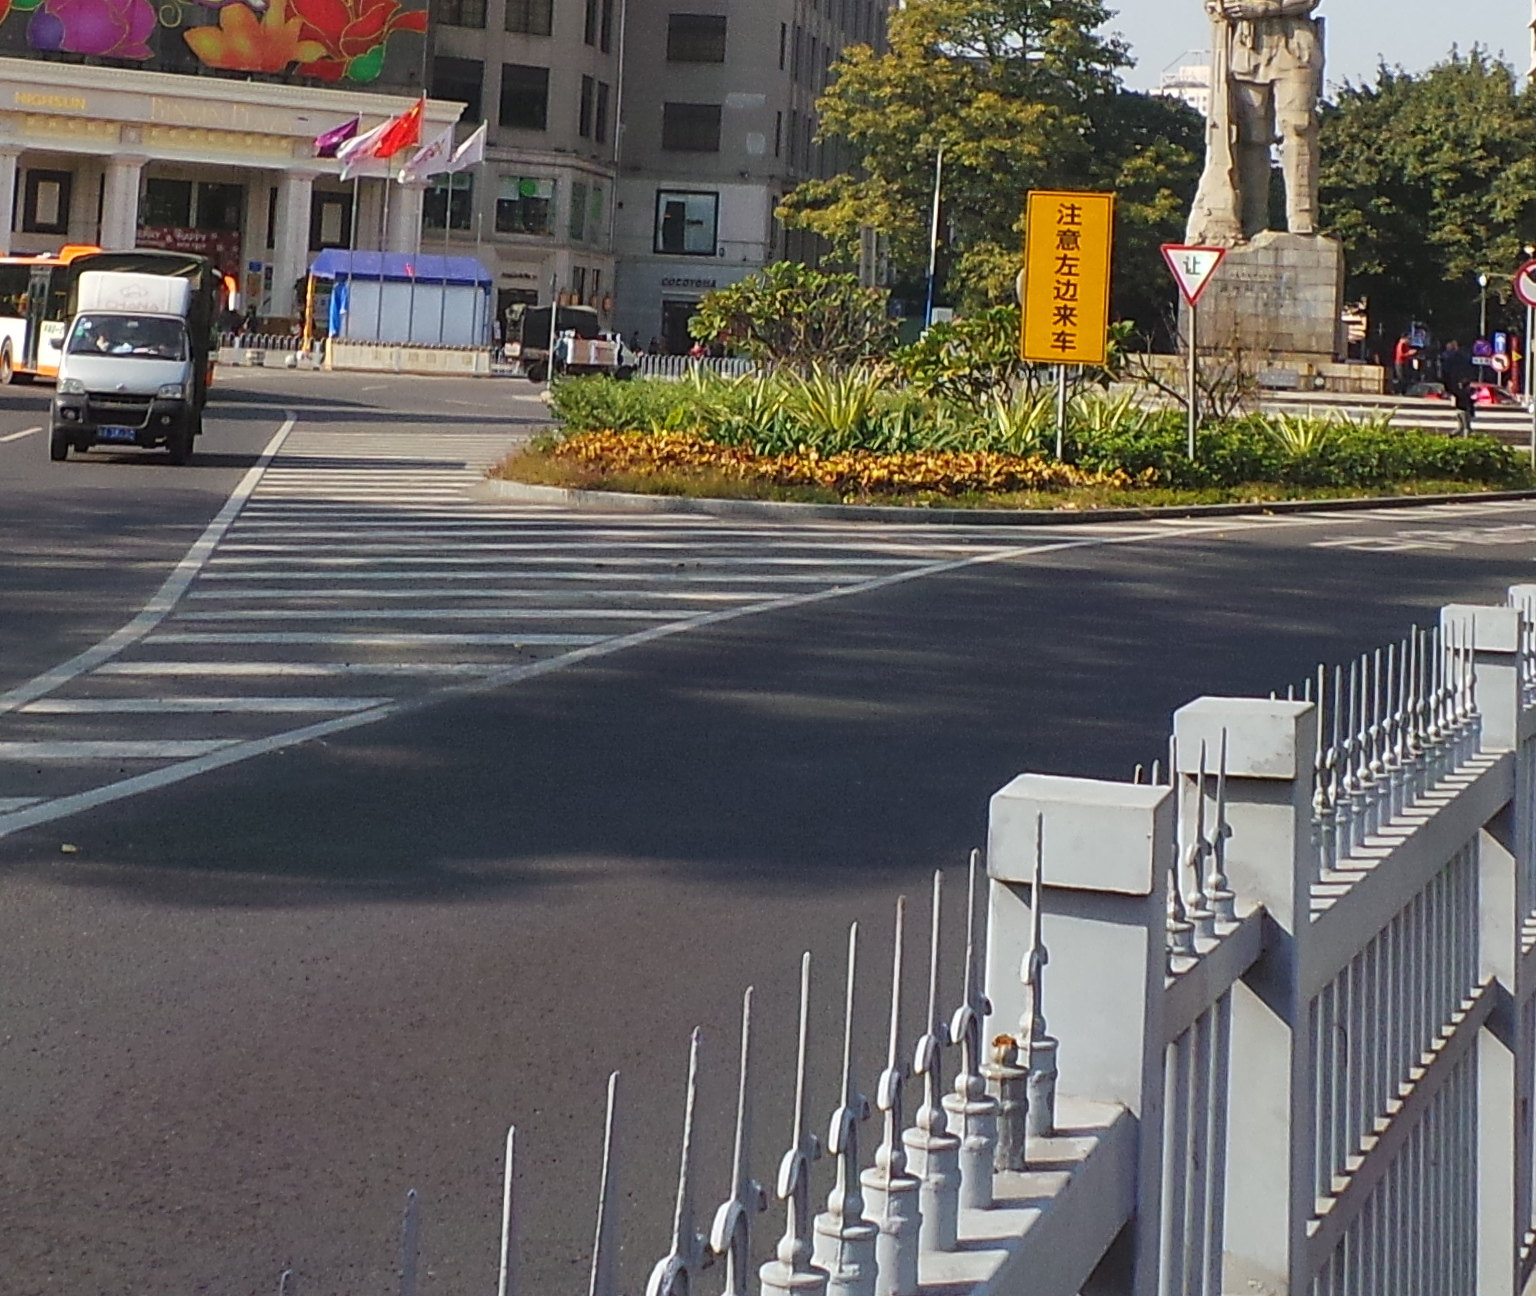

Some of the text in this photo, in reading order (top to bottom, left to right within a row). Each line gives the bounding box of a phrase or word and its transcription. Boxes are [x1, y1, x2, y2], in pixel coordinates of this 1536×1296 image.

[1050, 202, 1082, 354] 注意左边来车
[1182, 254, 1202, 277] 让
